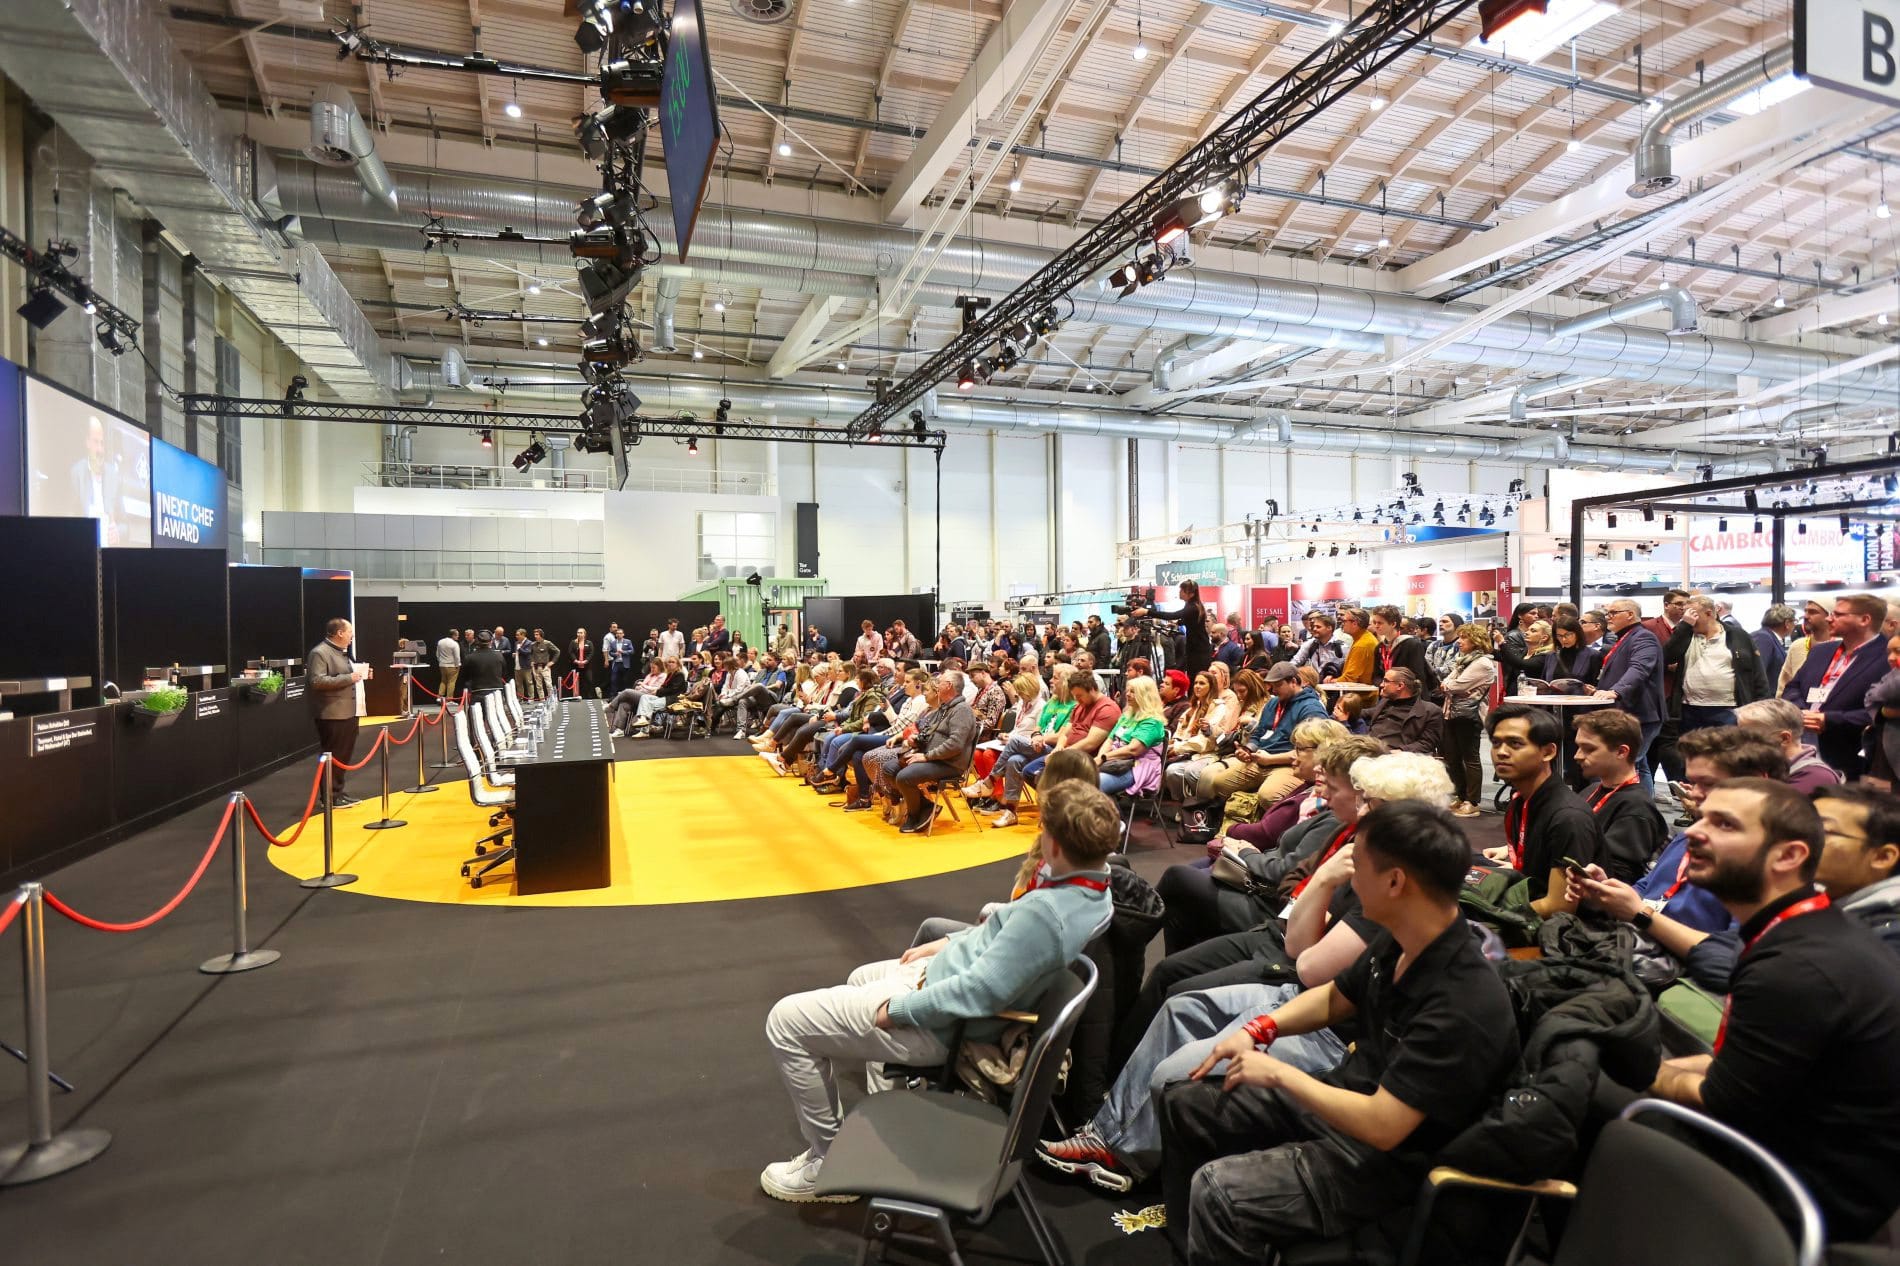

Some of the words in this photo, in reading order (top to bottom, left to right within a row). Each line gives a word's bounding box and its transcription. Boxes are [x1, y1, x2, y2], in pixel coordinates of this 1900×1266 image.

[1863, 9, 1896, 86] B
[162, 493, 190, 521] NEXT
[191, 503, 214, 528] CHEF
[162, 516, 199, 544] AWARD
[1256, 607, 1268, 615] SET
[1269, 607, 1284, 615] SAIL
